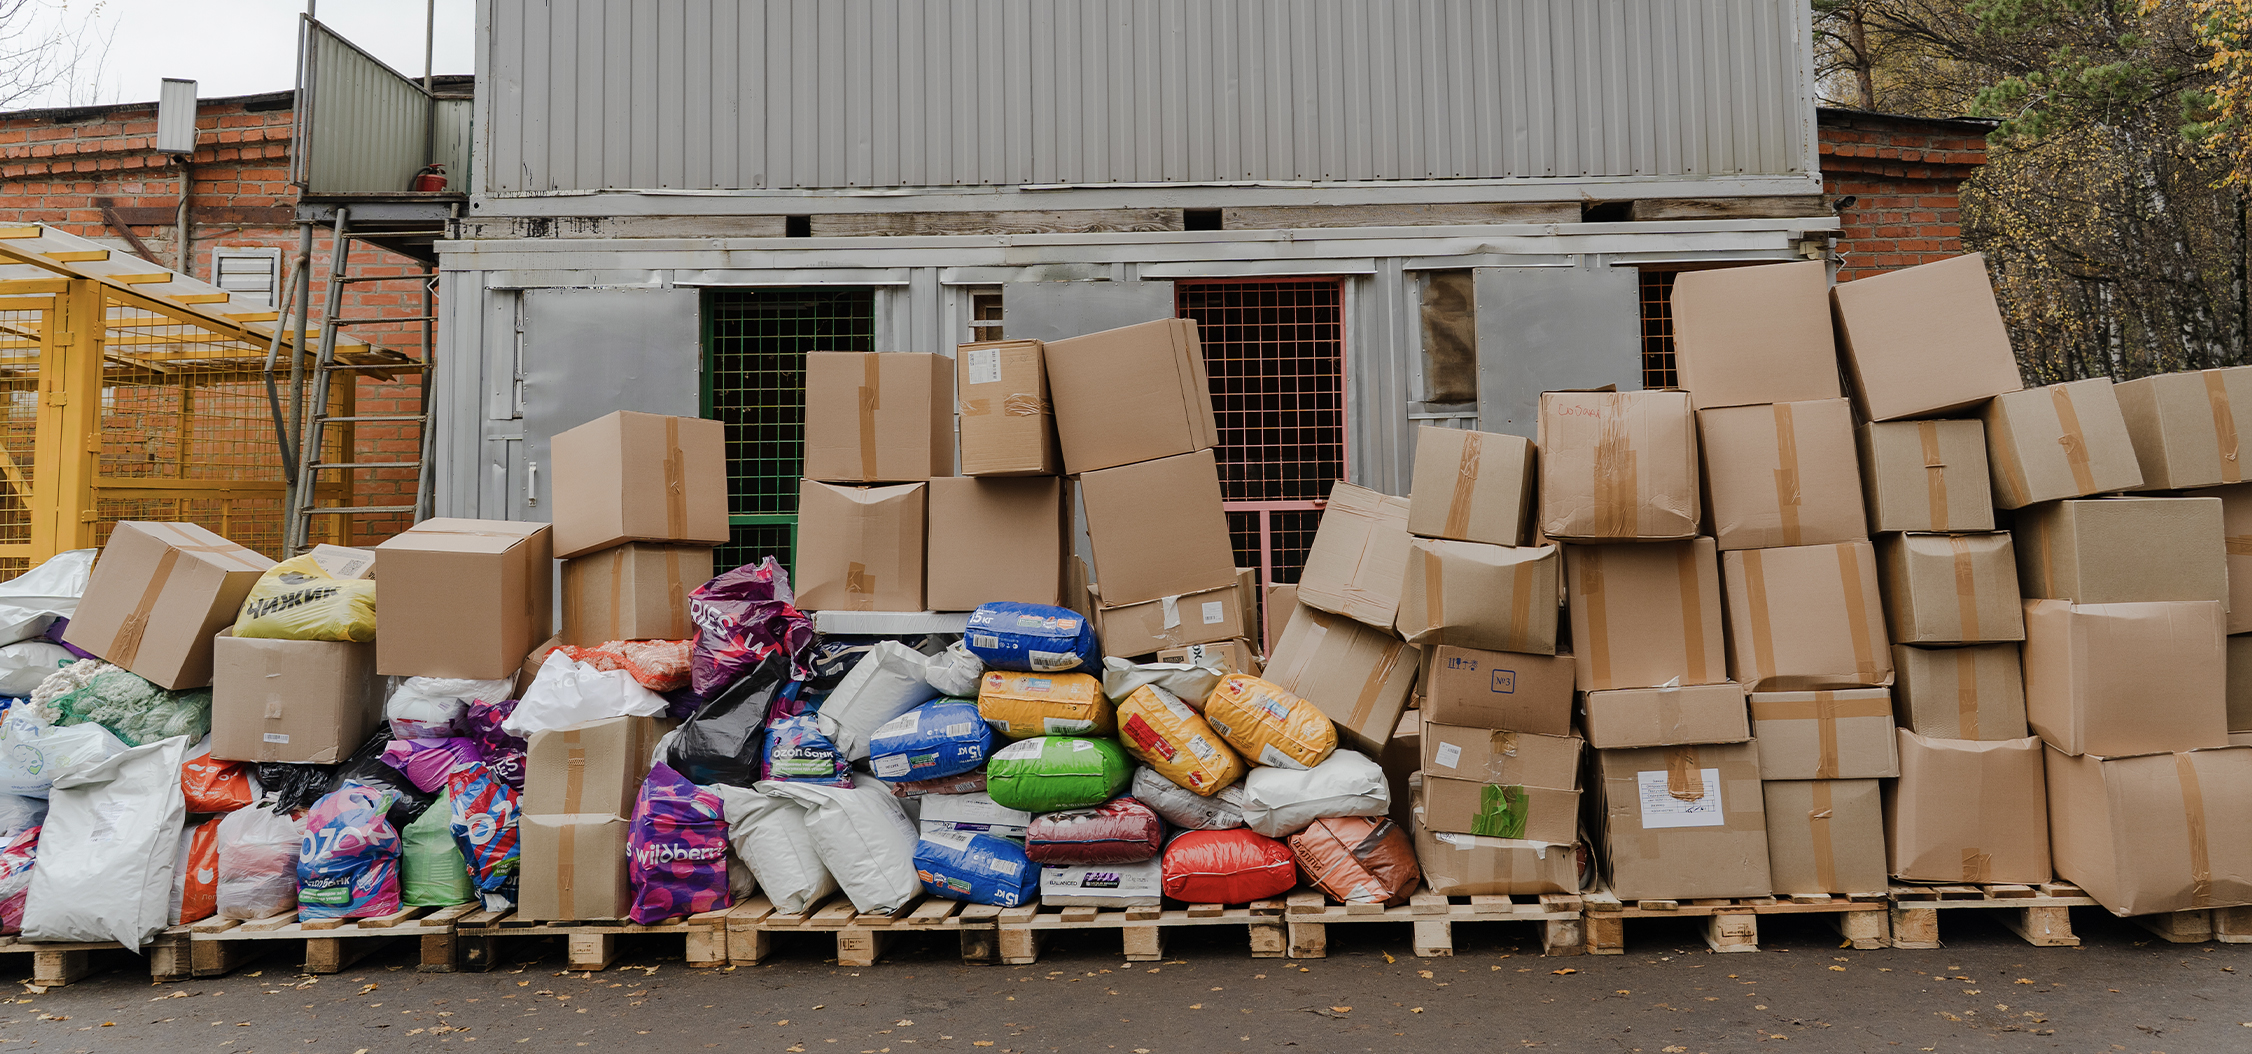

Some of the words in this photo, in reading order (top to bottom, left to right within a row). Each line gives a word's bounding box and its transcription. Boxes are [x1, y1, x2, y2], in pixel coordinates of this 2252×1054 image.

[247, 586, 341, 619] ЧИЖИК
[773, 748, 803, 758] ozon
[968, 744, 982, 759] 15
[1005, 891, 1019, 906] 15
